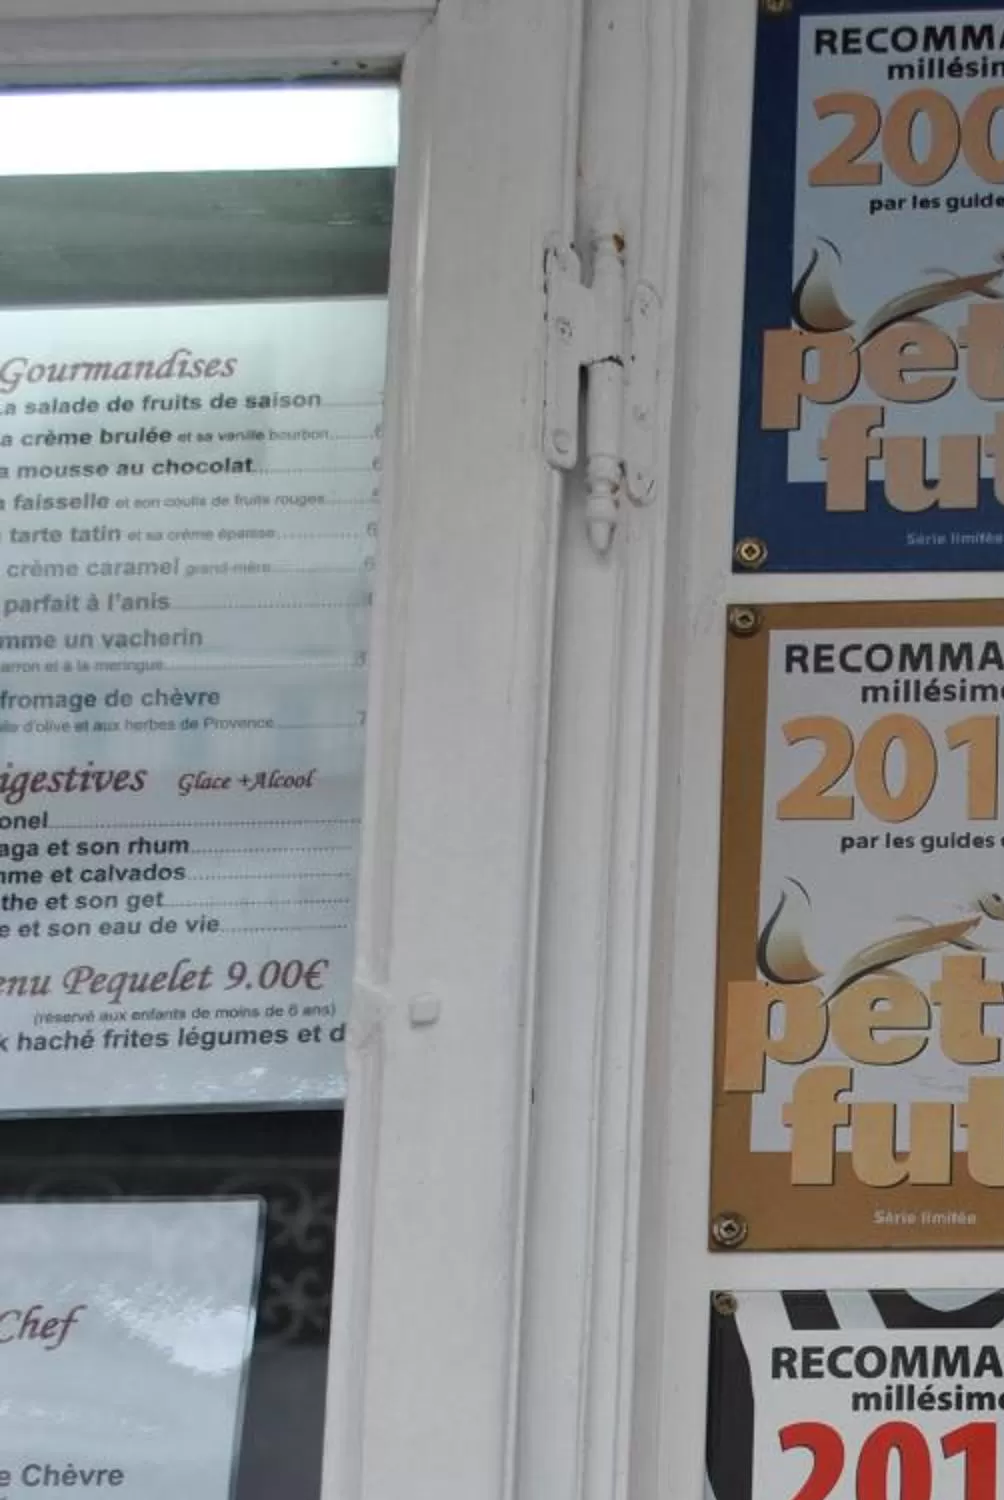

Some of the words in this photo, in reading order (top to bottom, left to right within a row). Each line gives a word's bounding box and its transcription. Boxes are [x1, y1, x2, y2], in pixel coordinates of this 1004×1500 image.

[869, 195, 906, 215] par
[912, 194, 941, 210] les
[0, 348, 238, 394] Gourmandises
[24, 396, 99, 415] salade
[106, 394, 135, 413] de
[142, 392, 201, 412] fruits
[210, 391, 238, 410] de
[245, 391, 321, 409] saison
[21, 429, 92, 447] crème
[100, 426, 172, 445] brulée
[177, 432, 191, 443] et
[17, 463, 110, 478] mousse
[116, 462, 144, 476] au
[151, 457, 254, 476] chocolat
[13, 491, 110, 511] faisselle
[9, 527, 63, 543] tarte
[70, 525, 121, 543] tatin
[906, 531, 945, 546] Série
[950, 530, 1004, 545] limitée
[6, 560, 80, 577] crème
[86, 556, 180, 577] caramel
[4, 593, 80, 618] parfait
[86, 592, 100, 612] à
[107, 591, 171, 612] l'anis
[64, 632, 94, 650] un
[101, 628, 203, 650] vacherin
[0, 689, 97, 713] fromage
[103, 688, 132, 707] de
[141, 687, 220, 707] chèvre
[203, 716, 274, 730] Provence
[177, 770, 231, 796] Glace
[47, 838, 69, 857] et
[76, 840, 119, 856] son
[127, 836, 190, 856] rhum
[840, 833, 879, 854] par
[885, 831, 915, 850] les
[920, 831, 996, 853] guides
[50, 866, 72, 883] et
[80, 863, 187, 883] calvados
[2, 892, 38, 912] the
[45, 893, 69, 910] et
[75, 894, 118, 910] son
[127, 891, 164, 914] get
[18, 919, 40, 938] et
[48, 921, 91, 938] son
[99, 919, 142, 936] eau
[149, 915, 178, 935] de
[185, 914, 220, 933] vie
[62, 957, 213, 1004] Pequelet
[223, 958, 329, 993] 9.00€
[131, 1008, 186, 1022] enfants
[191, 1007, 210, 1020] de
[215, 1006, 259, 1020] moins
[264, 1005, 284, 1018] de
[17, 1029, 95, 1051] haché
[103, 1027, 169, 1050] frites
[177, 1025, 289, 1051] légumes
[297, 1023, 321, 1043] et
[872, 1209, 916, 1225] Série
[920, 1209, 977, 1225] limitée
[0, 1304, 88, 1352] Chef
[21, 1463, 125, 1487] Chèvre
